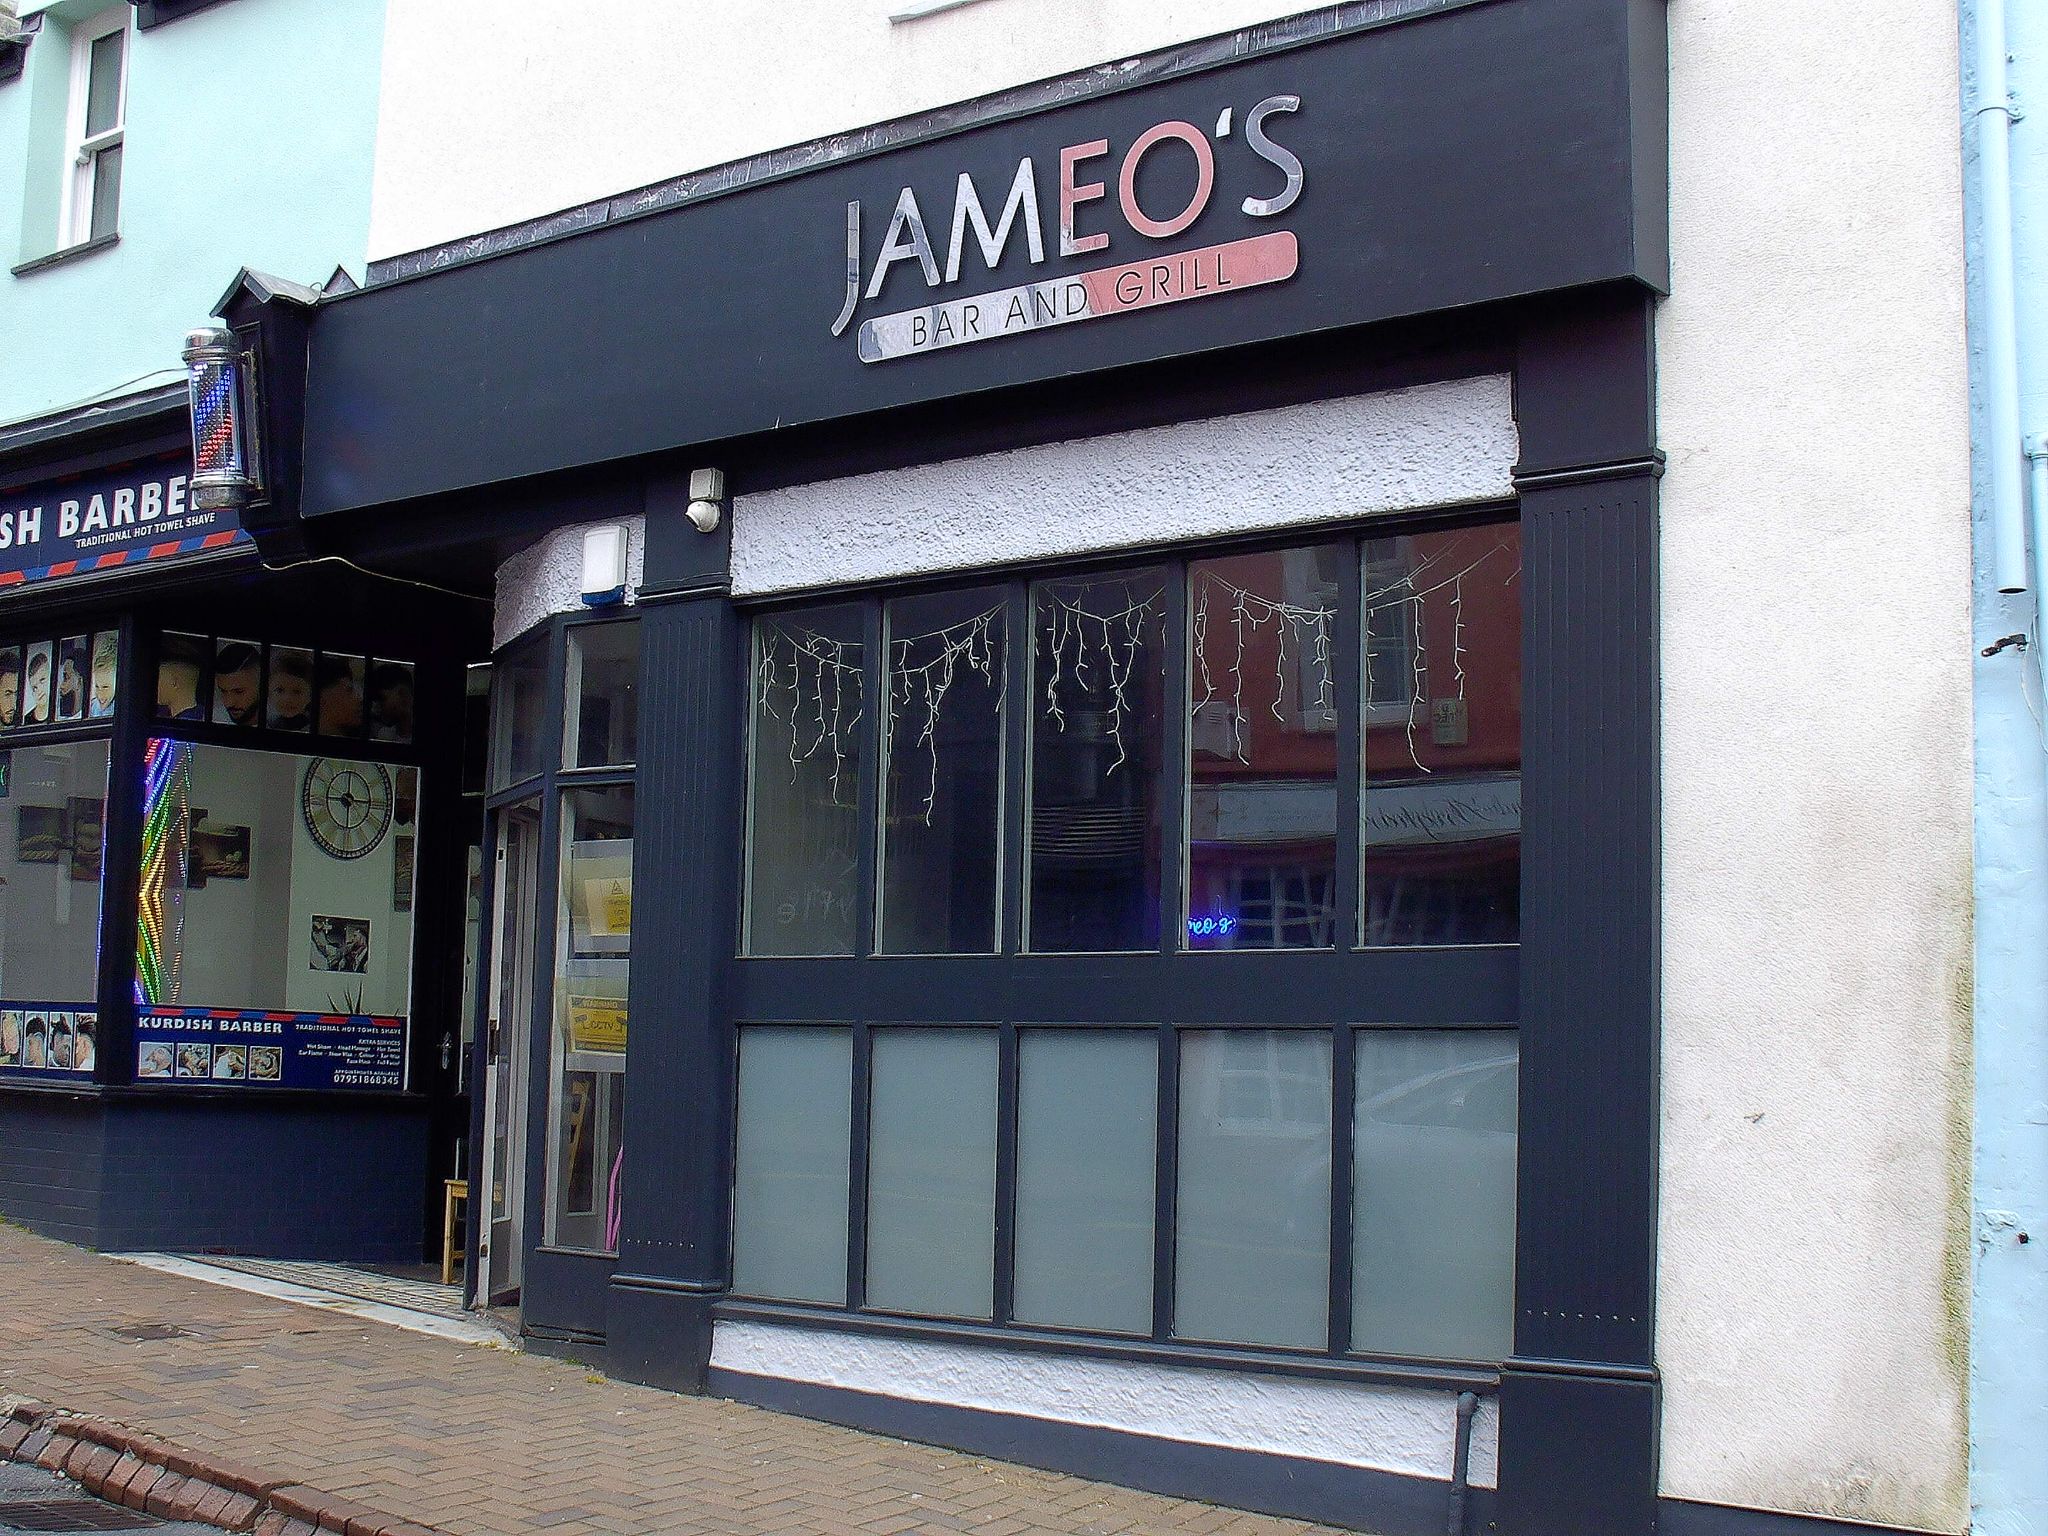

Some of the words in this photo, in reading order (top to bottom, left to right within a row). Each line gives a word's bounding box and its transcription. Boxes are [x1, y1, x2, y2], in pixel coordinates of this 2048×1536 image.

[830, 94, 1305, 337] JAMEO'S
[911, 304, 981, 347] BAR
[1004, 282, 1089, 329] AND
[1114, 253, 1232, 306] GRILL
[74, 529, 132, 549] TRADITIONAL
[133, 525, 153, 538] HOT
[154, 519, 184, 533] TOWEL
[185, 512, 216, 527] SHAVE
[138, 1017, 213, 1031] KURDISH
[219, 1020, 283, 1034] BARBER
[295, 1024, 340, 1032] TRADITIONAL
[333, 1074, 399, 1086] 07951868345
